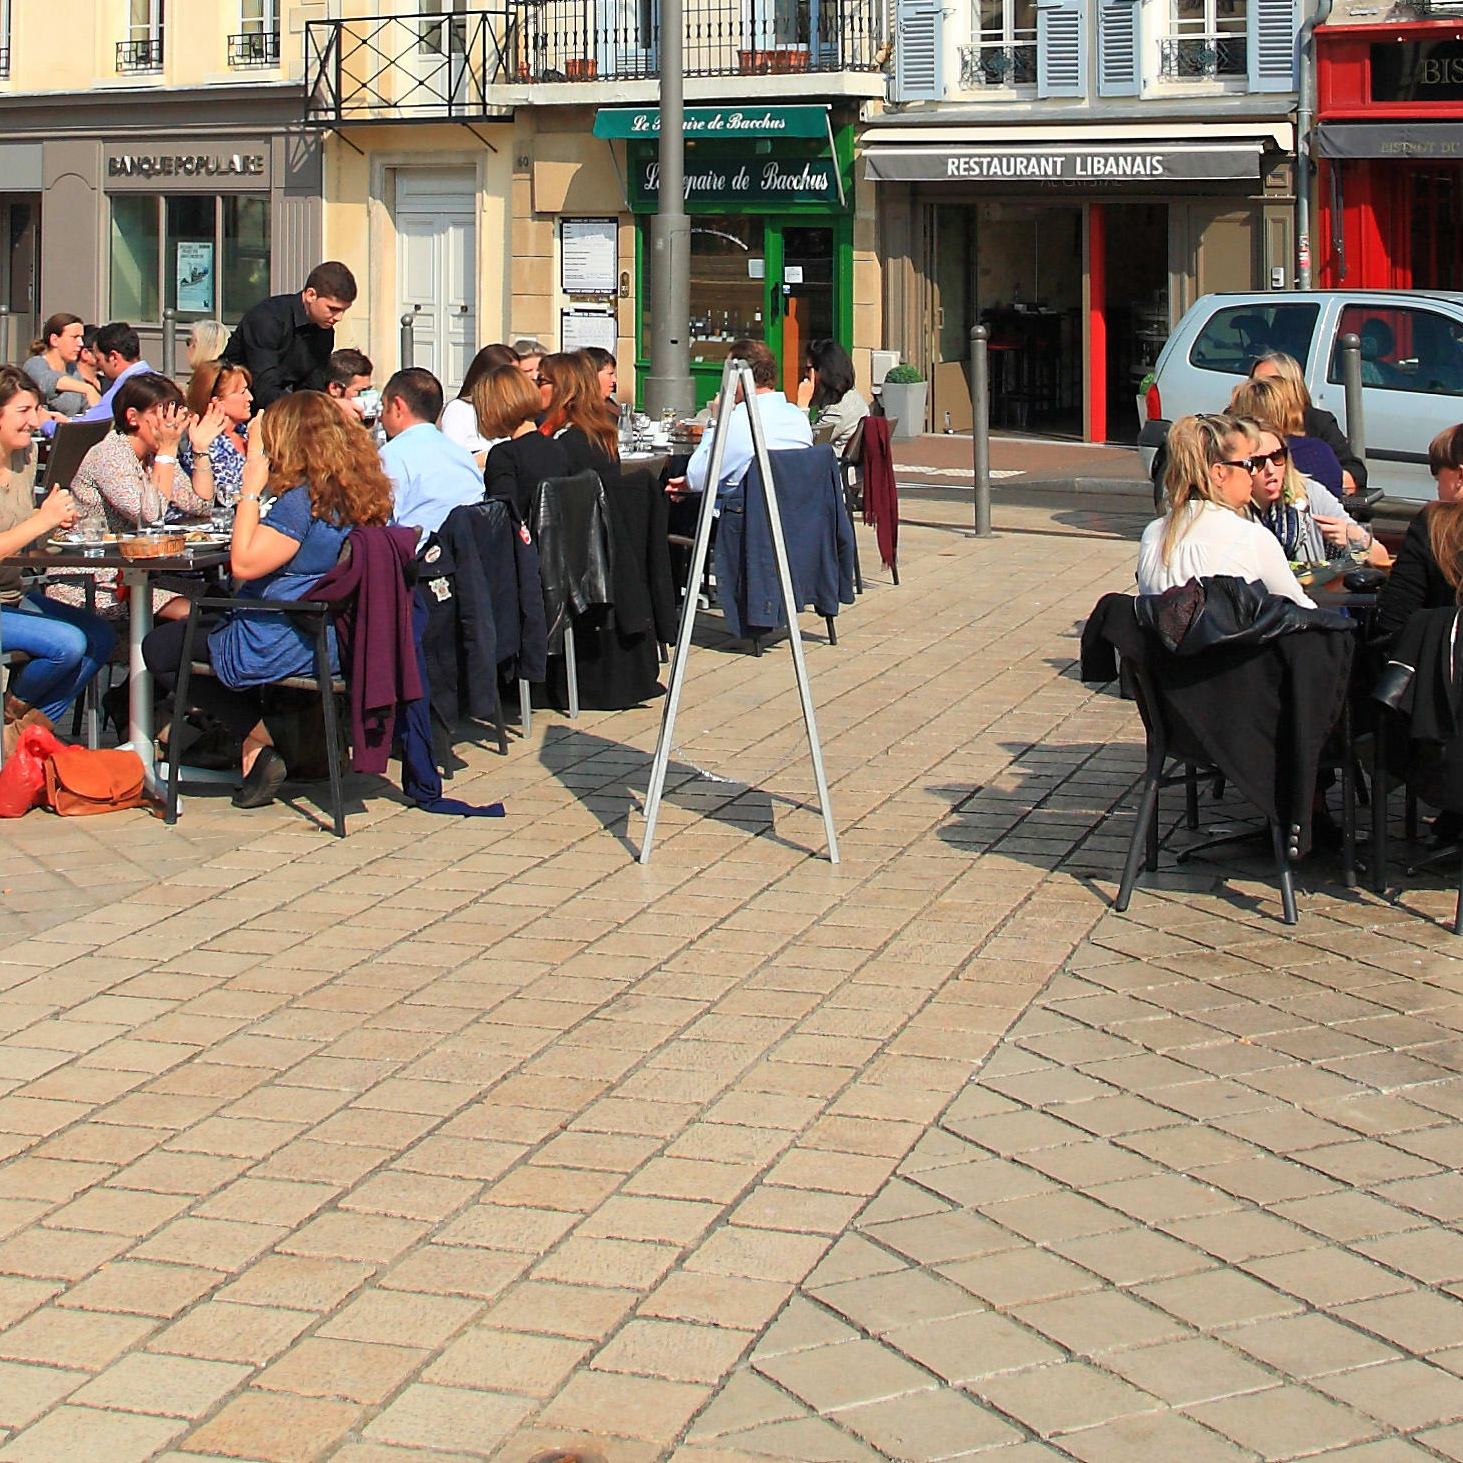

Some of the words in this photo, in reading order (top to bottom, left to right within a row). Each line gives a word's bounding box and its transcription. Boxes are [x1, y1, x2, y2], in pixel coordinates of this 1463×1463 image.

[631, 114, 650, 131] Le
[707, 113, 725, 130] de
[726, 111, 786, 130] Bacchus
[108, 154, 174, 180] BANQUE
[731, 164, 750, 191] de
[760, 161, 829, 191] Bacchus
[947, 156, 1066, 176] RESTAURANT
[1075, 155, 1164, 175] LIBANAIS
